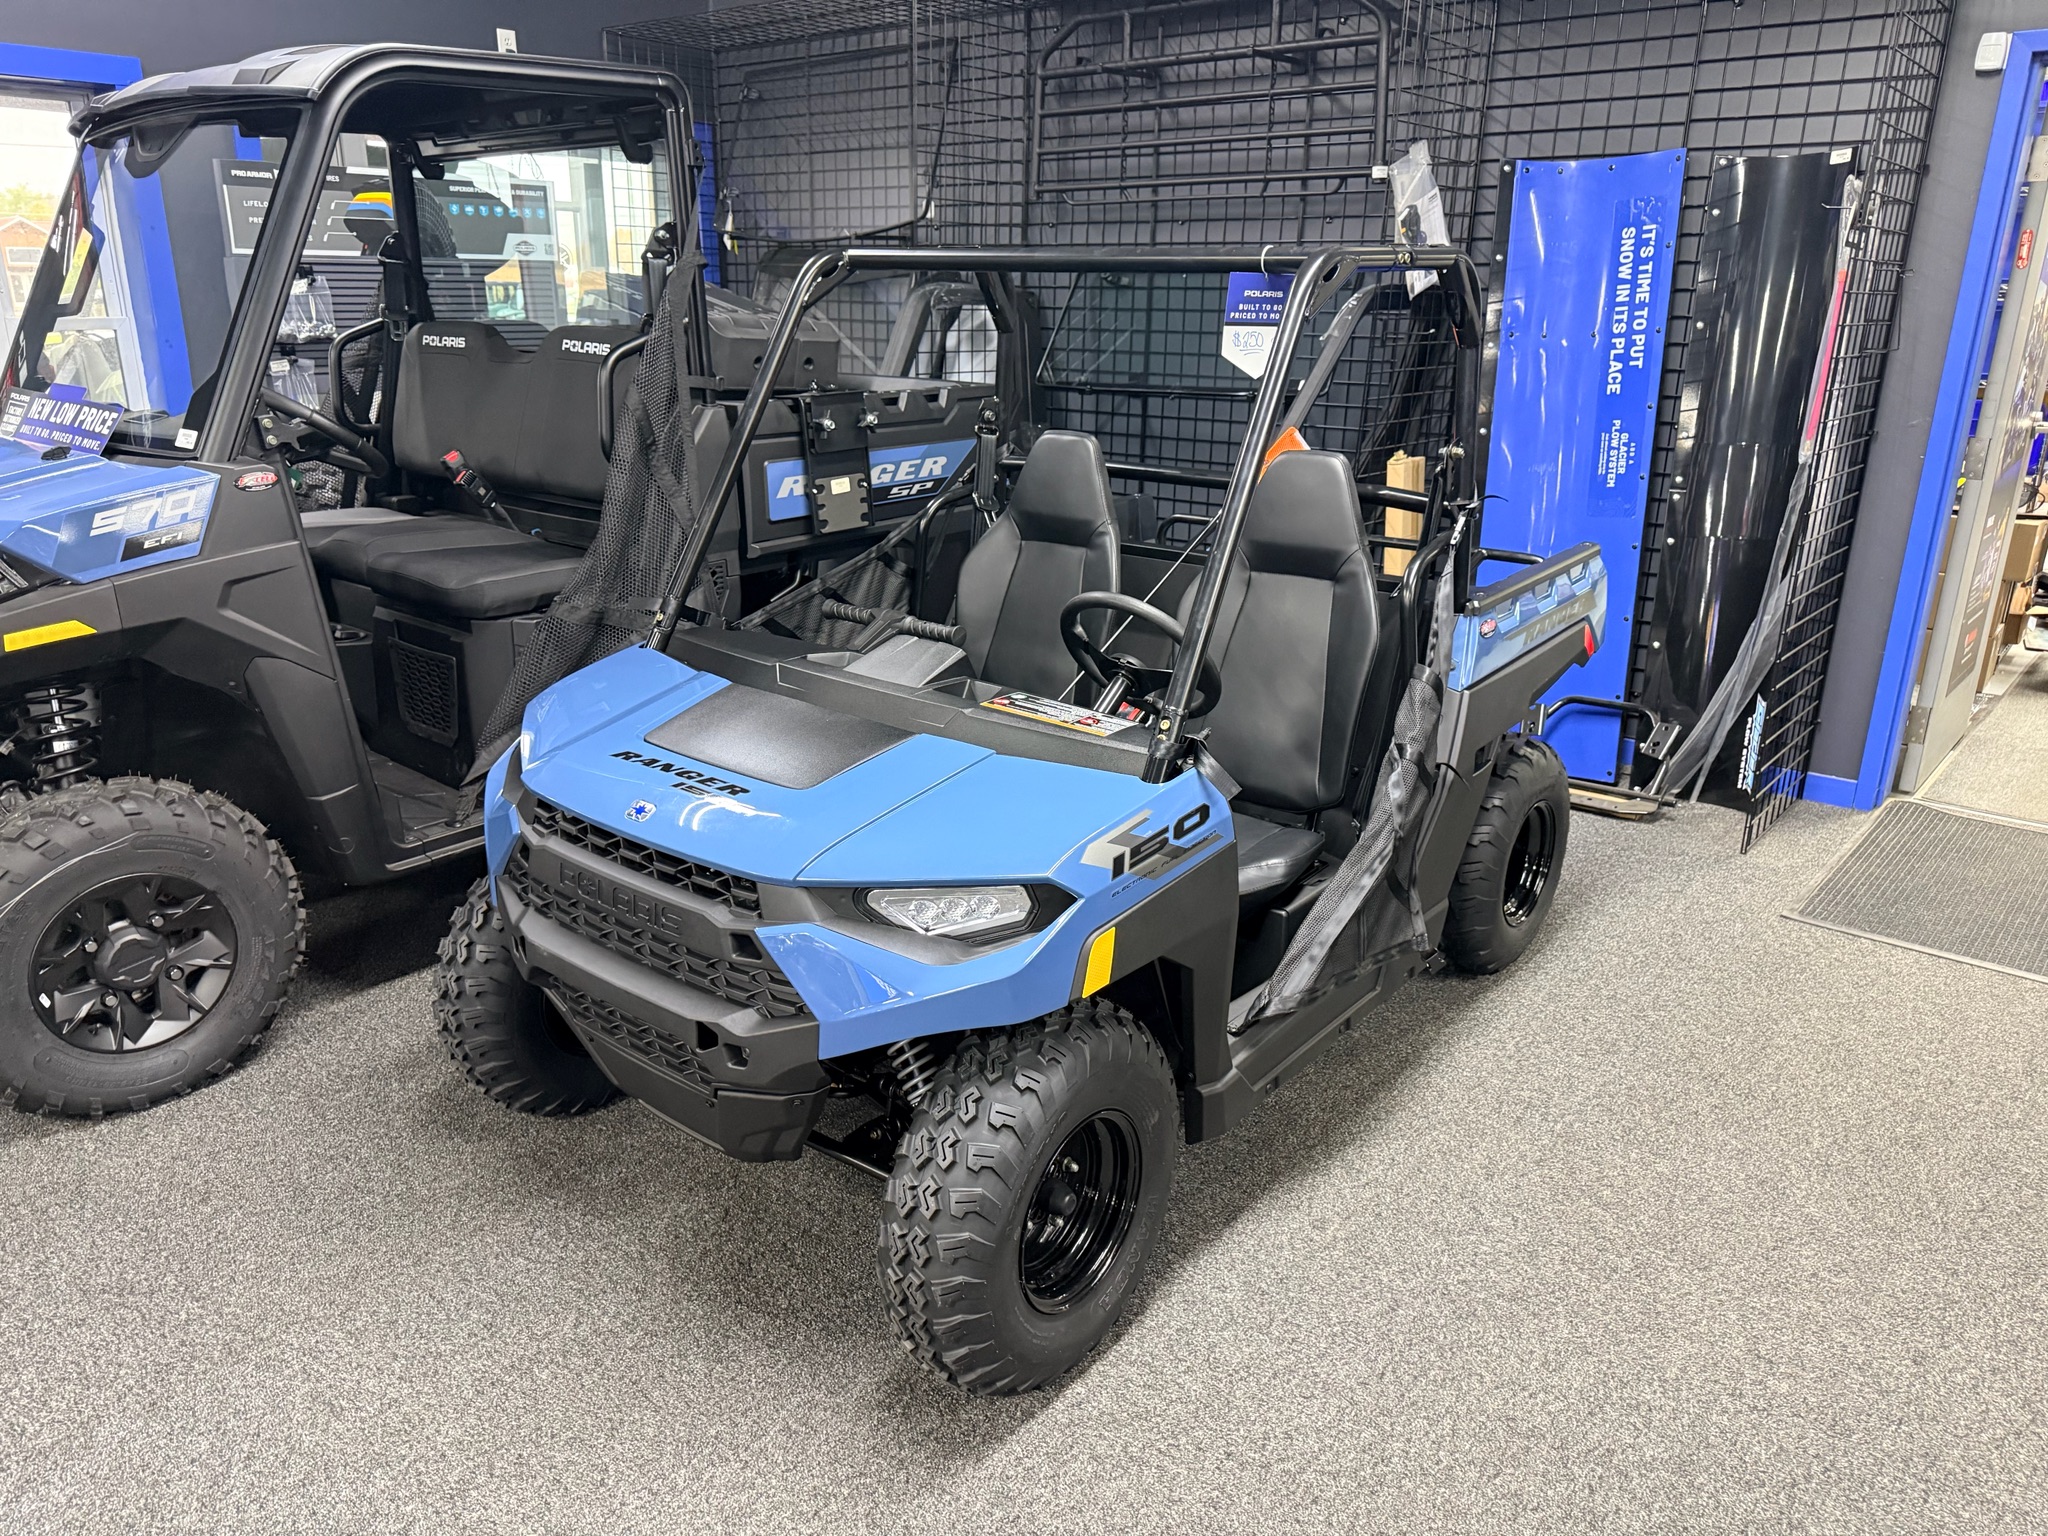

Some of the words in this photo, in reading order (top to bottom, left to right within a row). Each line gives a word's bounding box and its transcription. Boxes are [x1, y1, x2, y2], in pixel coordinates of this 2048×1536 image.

[243, 200, 268, 208] LIFELO
[1617, 226, 1636, 279] SNOW
[1640, 223, 1657, 259] IT'S
[1243, 290, 1284, 298] POLARIS
[1615, 284, 1631, 303] IN
[1635, 261, 1653, 304] TIME
[1259, 312, 1268, 320] TO
[1612, 306, 1628, 334] ITS
[1632, 307, 1648, 331] TO
[422, 335, 466, 348] POLARIS
[561, 339, 611, 356] POLARIS
[1629, 334, 1646, 369] PUT
[1607, 338, 1626, 395] PLACE
[10, 392, 31, 402] POLARIS
[27, 397, 56, 421] NEW
[49, 401, 80, 426] LOW
[74, 405, 119, 435] PRICE
[34, 428, 42, 436] TO
[51, 431, 73, 444] PRICED
[73, 436, 82, 446] TO
[81, 438, 101, 451] MOVE.
[1611, 419, 1621, 448] PLOW
[1606, 449, 1618, 487] SYSTEM
[1617, 433, 1629, 474] GLACIER
[776, 456, 947, 498] RGER
[887, 481, 934, 498] SP
[90, 489, 199, 536] 570
[143, 533, 183, 549] EFI
[609, 750, 751, 796] RANGER
[1111, 803, 1211, 881] 150
[559, 862, 682, 938] POLARIS
